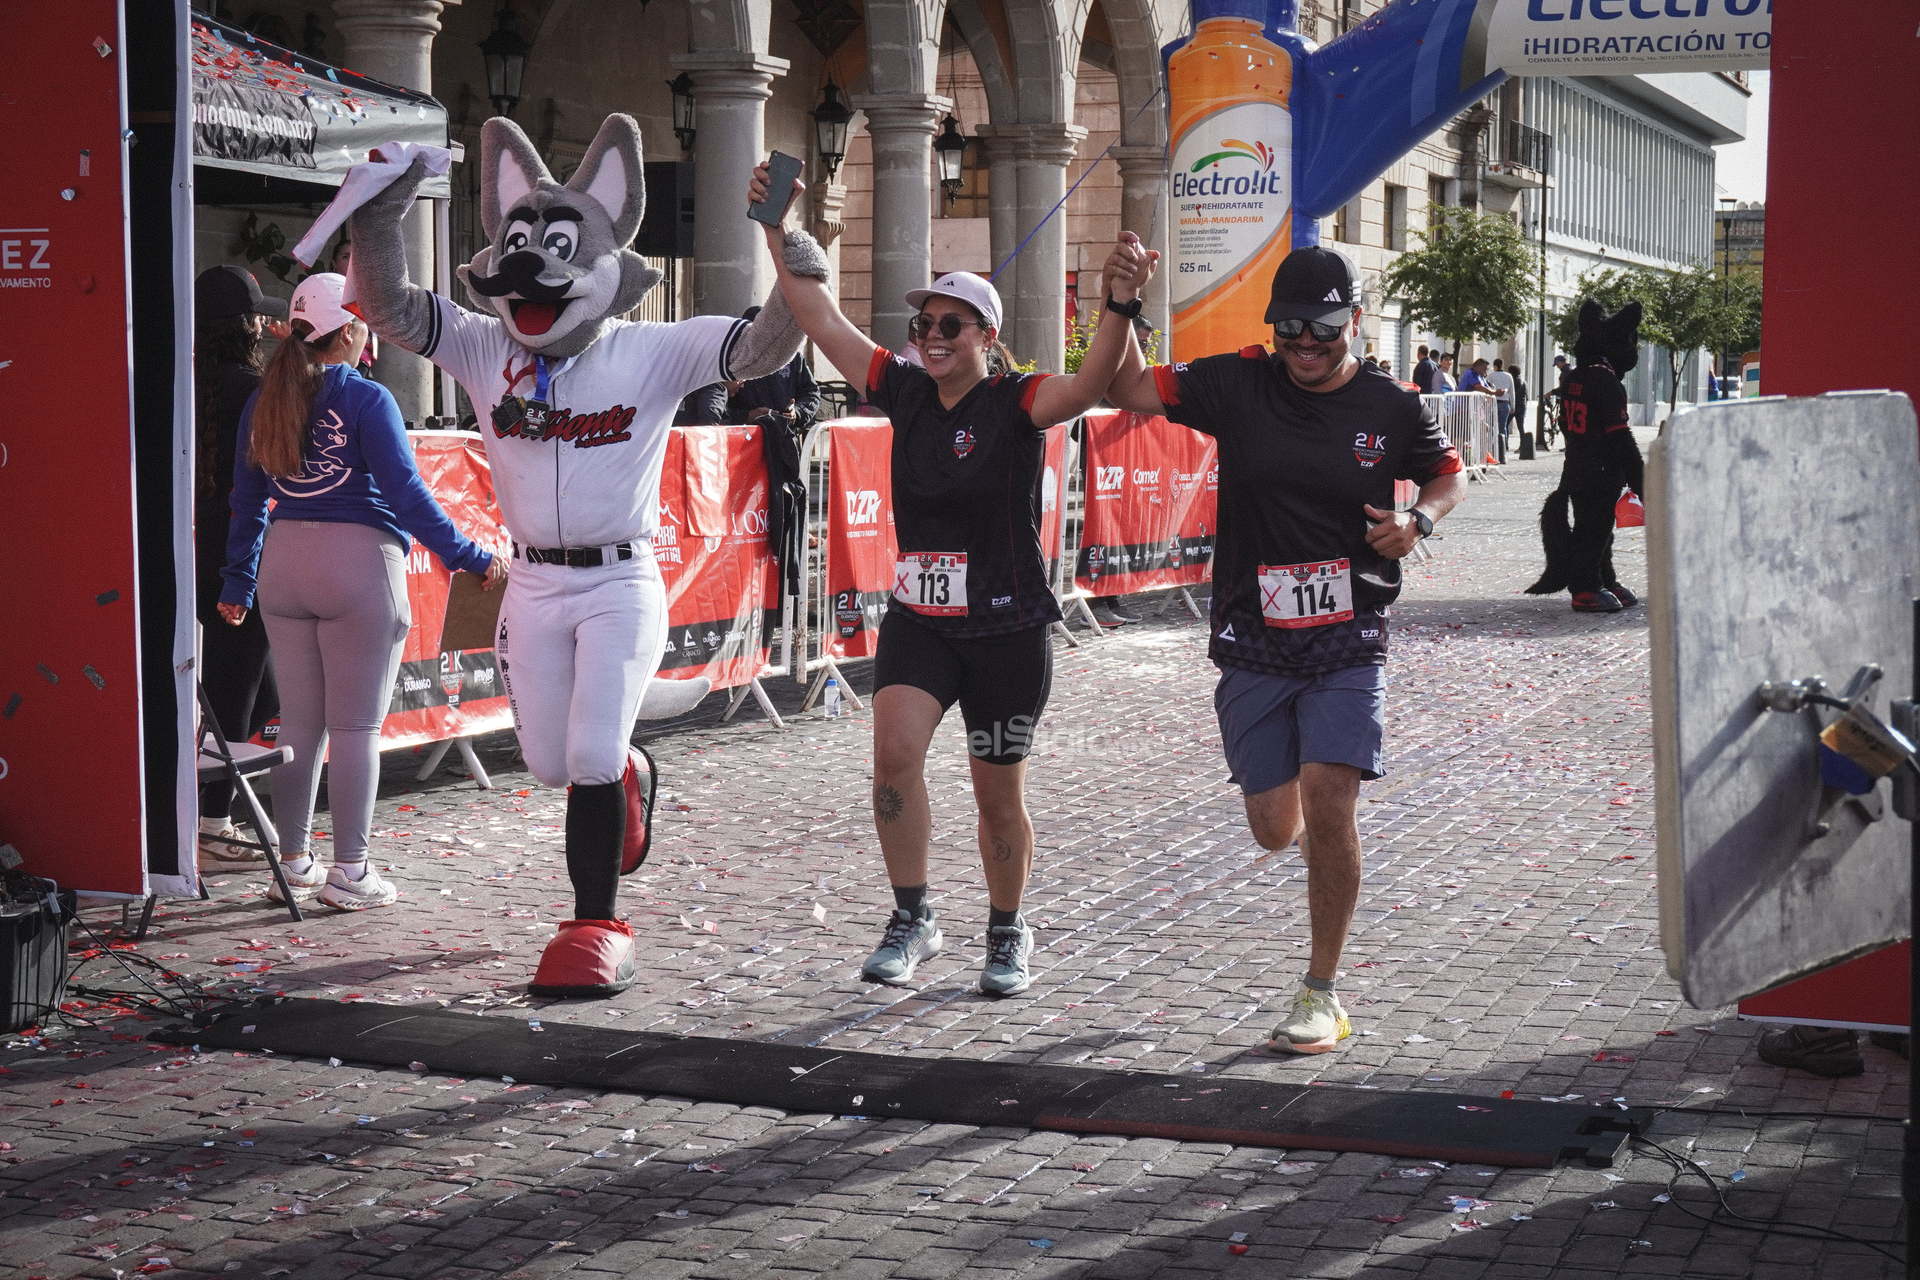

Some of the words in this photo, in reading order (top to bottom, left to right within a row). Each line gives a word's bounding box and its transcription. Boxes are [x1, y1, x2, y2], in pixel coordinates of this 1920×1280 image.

[1173, 170, 1280, 198] Electrolit
[1202, 202, 1264, 210] REHIDRATANTE
[1180, 216, 1264, 226] NARANJA-MANDARINA
[1179, 263, 1196, 273] 625
[1197, 262, 1213, 272] mL
[0, 277, 51, 288] VAMENTO
[585, 431, 632, 448] DURANGO
[1096, 463, 1126, 492] DZR
[1133, 466, 1161, 485] Comex
[846, 486, 882, 527] DZR
[918, 572, 950, 606] 113
[991, 595, 1012, 606] DZR
[1292, 582, 1337, 617] 114
[1360, 629, 1380, 638] DZR
[404, 678, 432, 692] DURANGO
